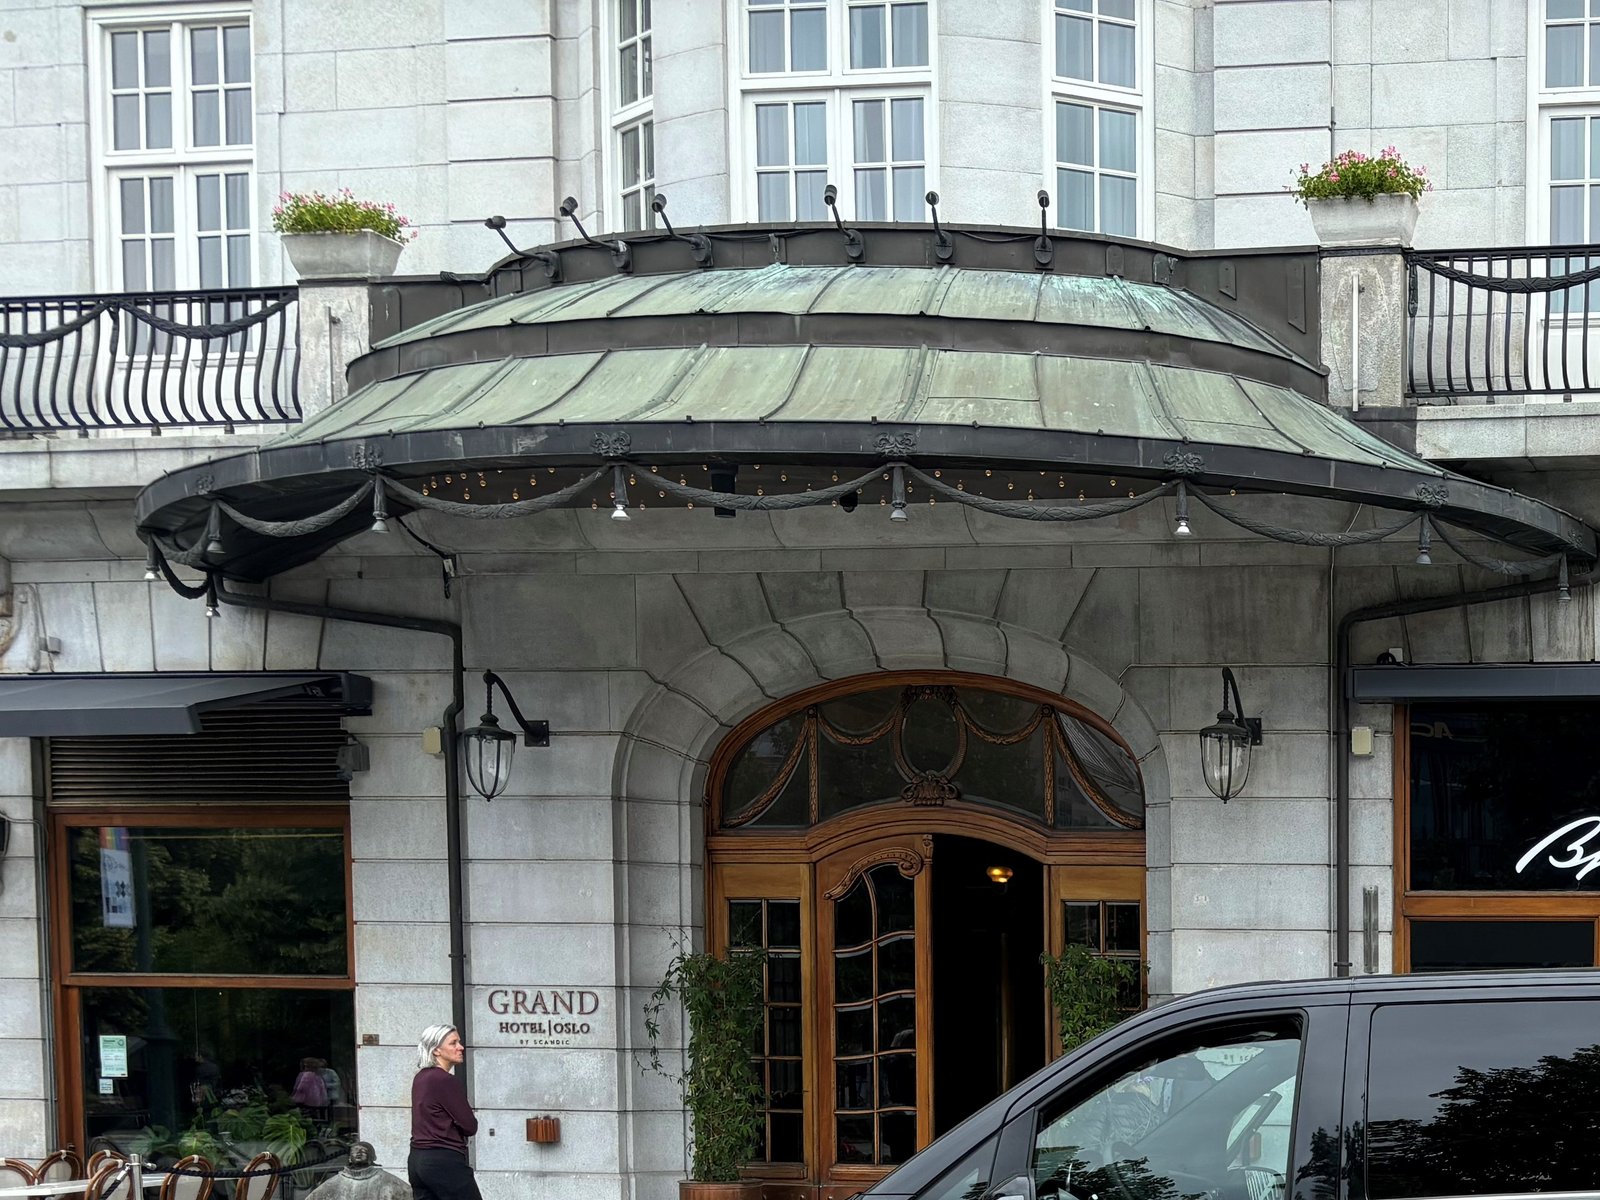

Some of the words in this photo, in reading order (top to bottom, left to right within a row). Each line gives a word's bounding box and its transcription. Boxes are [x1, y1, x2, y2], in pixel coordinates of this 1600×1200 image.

[488, 990, 600, 1015] GRAND
[499, 1022, 546, 1034] HOTEL
[553, 1023, 591, 1034] OSLO
